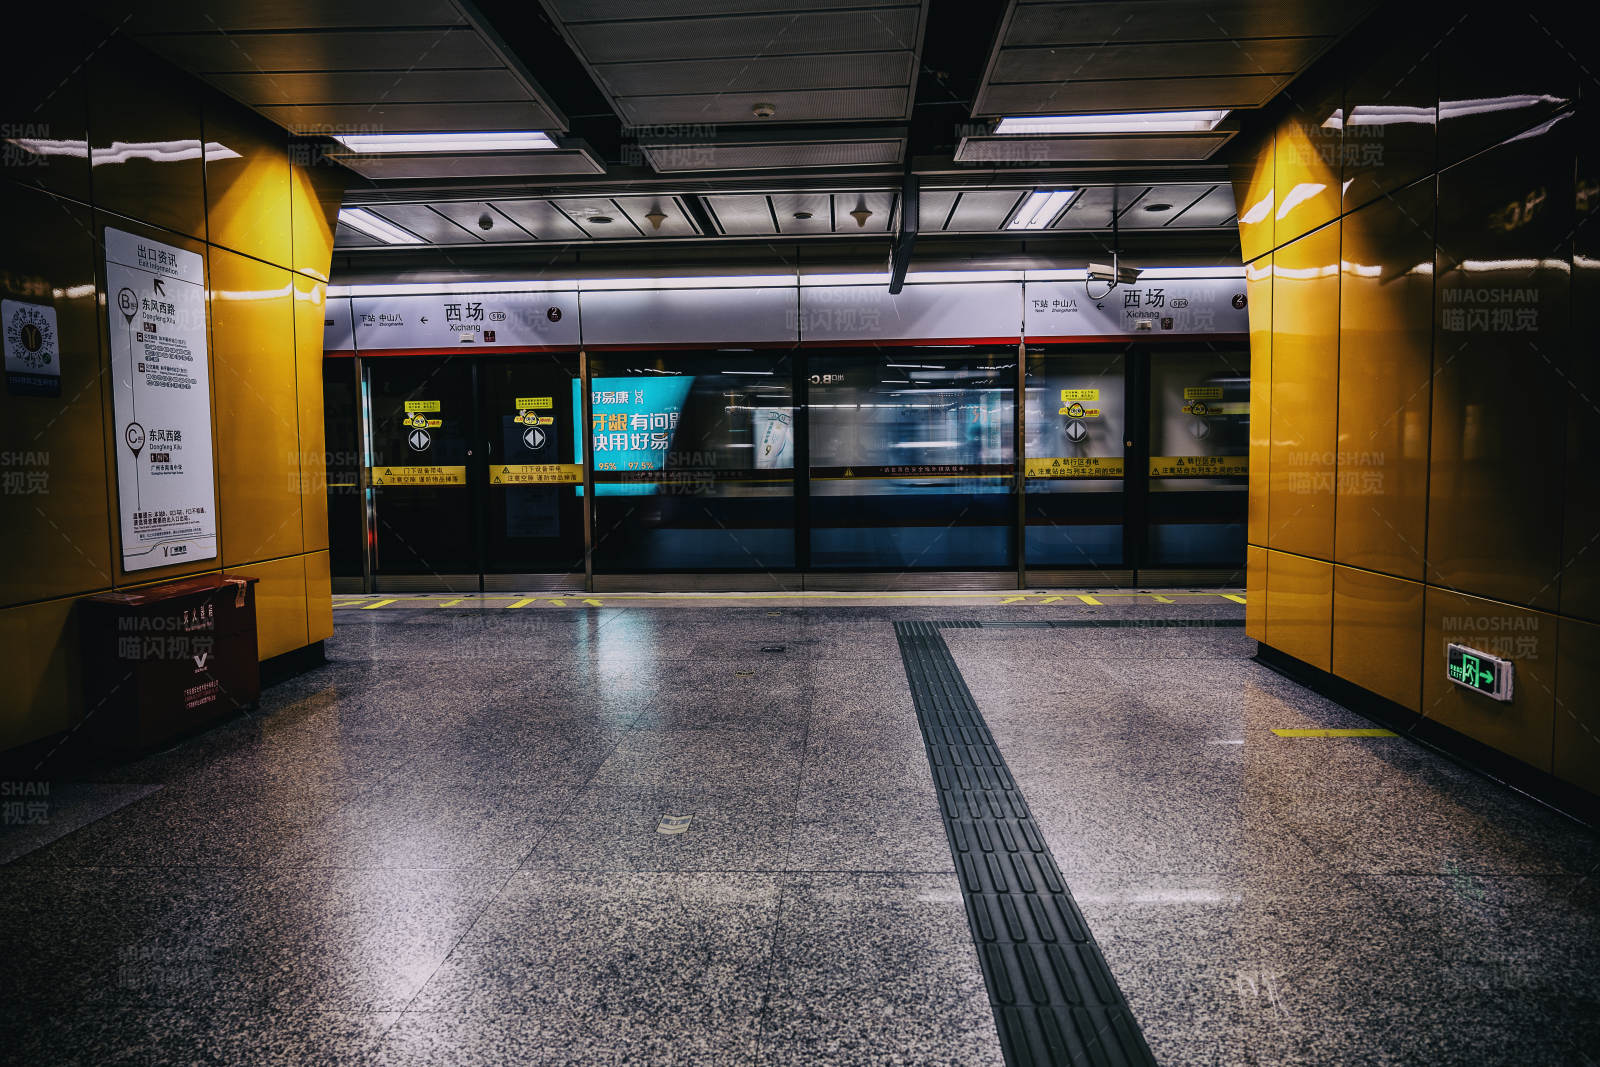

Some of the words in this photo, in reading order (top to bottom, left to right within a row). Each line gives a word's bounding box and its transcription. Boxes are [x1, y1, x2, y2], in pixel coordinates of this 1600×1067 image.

[137, 244, 177, 267] 出口资讯
[1032, 300, 1048, 308] 下站
[1052, 299, 1077, 308] 中山八
[1123, 288, 1165, 308] 西场
[142, 298, 175, 315] 东风西路
[444, 302, 484, 322] 西场
[360, 314, 375, 323] 下站
[379, 313, 402, 322] 中山八
[1126, 310, 1160, 319] Xichang
[450, 323, 481, 333] Xichang
[592, 391, 628, 404] 好易康
[149, 429, 182, 442] 东风西路
[593, 433, 674, 451] 快用好易
[599, 462, 617, 470] 95%
[628, 462, 654, 470] 97.5%
